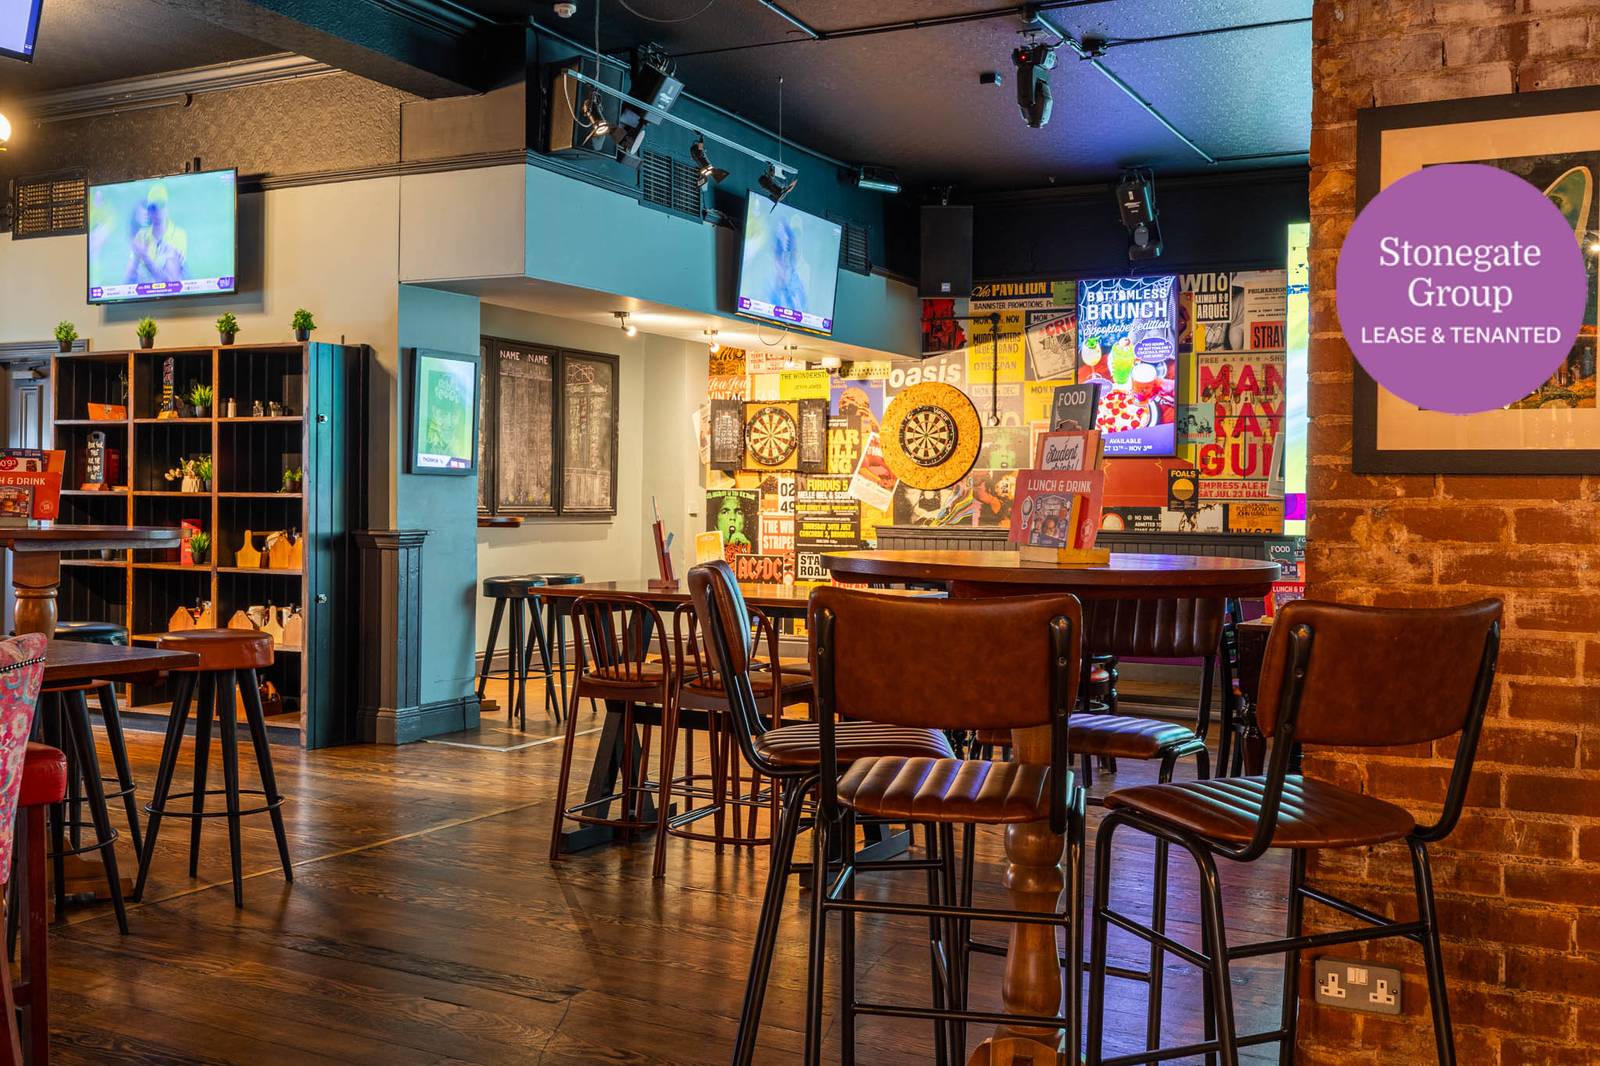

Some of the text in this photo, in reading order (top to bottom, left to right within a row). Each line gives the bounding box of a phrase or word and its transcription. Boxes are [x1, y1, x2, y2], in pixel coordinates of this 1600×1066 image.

[991, 281, 1047, 297] PAVILION
[1086, 288, 1168, 303] BOTTOMLESS
[973, 302, 1006, 311] BANNISTER
[1007, 300, 1043, 309] PROMOTIONS
[1086, 301, 1168, 321] BRUNCH
[1196, 302, 1229, 320] ARQUEE
[1005, 316, 1020, 324] NOV
[499, 350, 549, 365] NAME NAME
[889, 358, 963, 389] oasis
[1058, 390, 1087, 407] FOOD
[1045, 442, 1080, 465] Student
[1170, 470, 1197, 478] FOALS
[7, 477, 14, 485] &
[16, 477, 46, 486] DRINK
[1027, 479, 1057, 492] LUNCH
[1065, 480, 1092, 493] DRINK
[1199, 481, 1240, 490] EMPRESS
[1241, 480, 1260, 489] ALE
[1215, 490, 1230, 498] JUL
[1231, 490, 1242, 498] 23
[763, 519, 778, 533] THE
[1270, 545, 1291, 553] FOOD
[800, 566, 828, 577] ROAD
[1272, 585, 1293, 593] LUNCH
